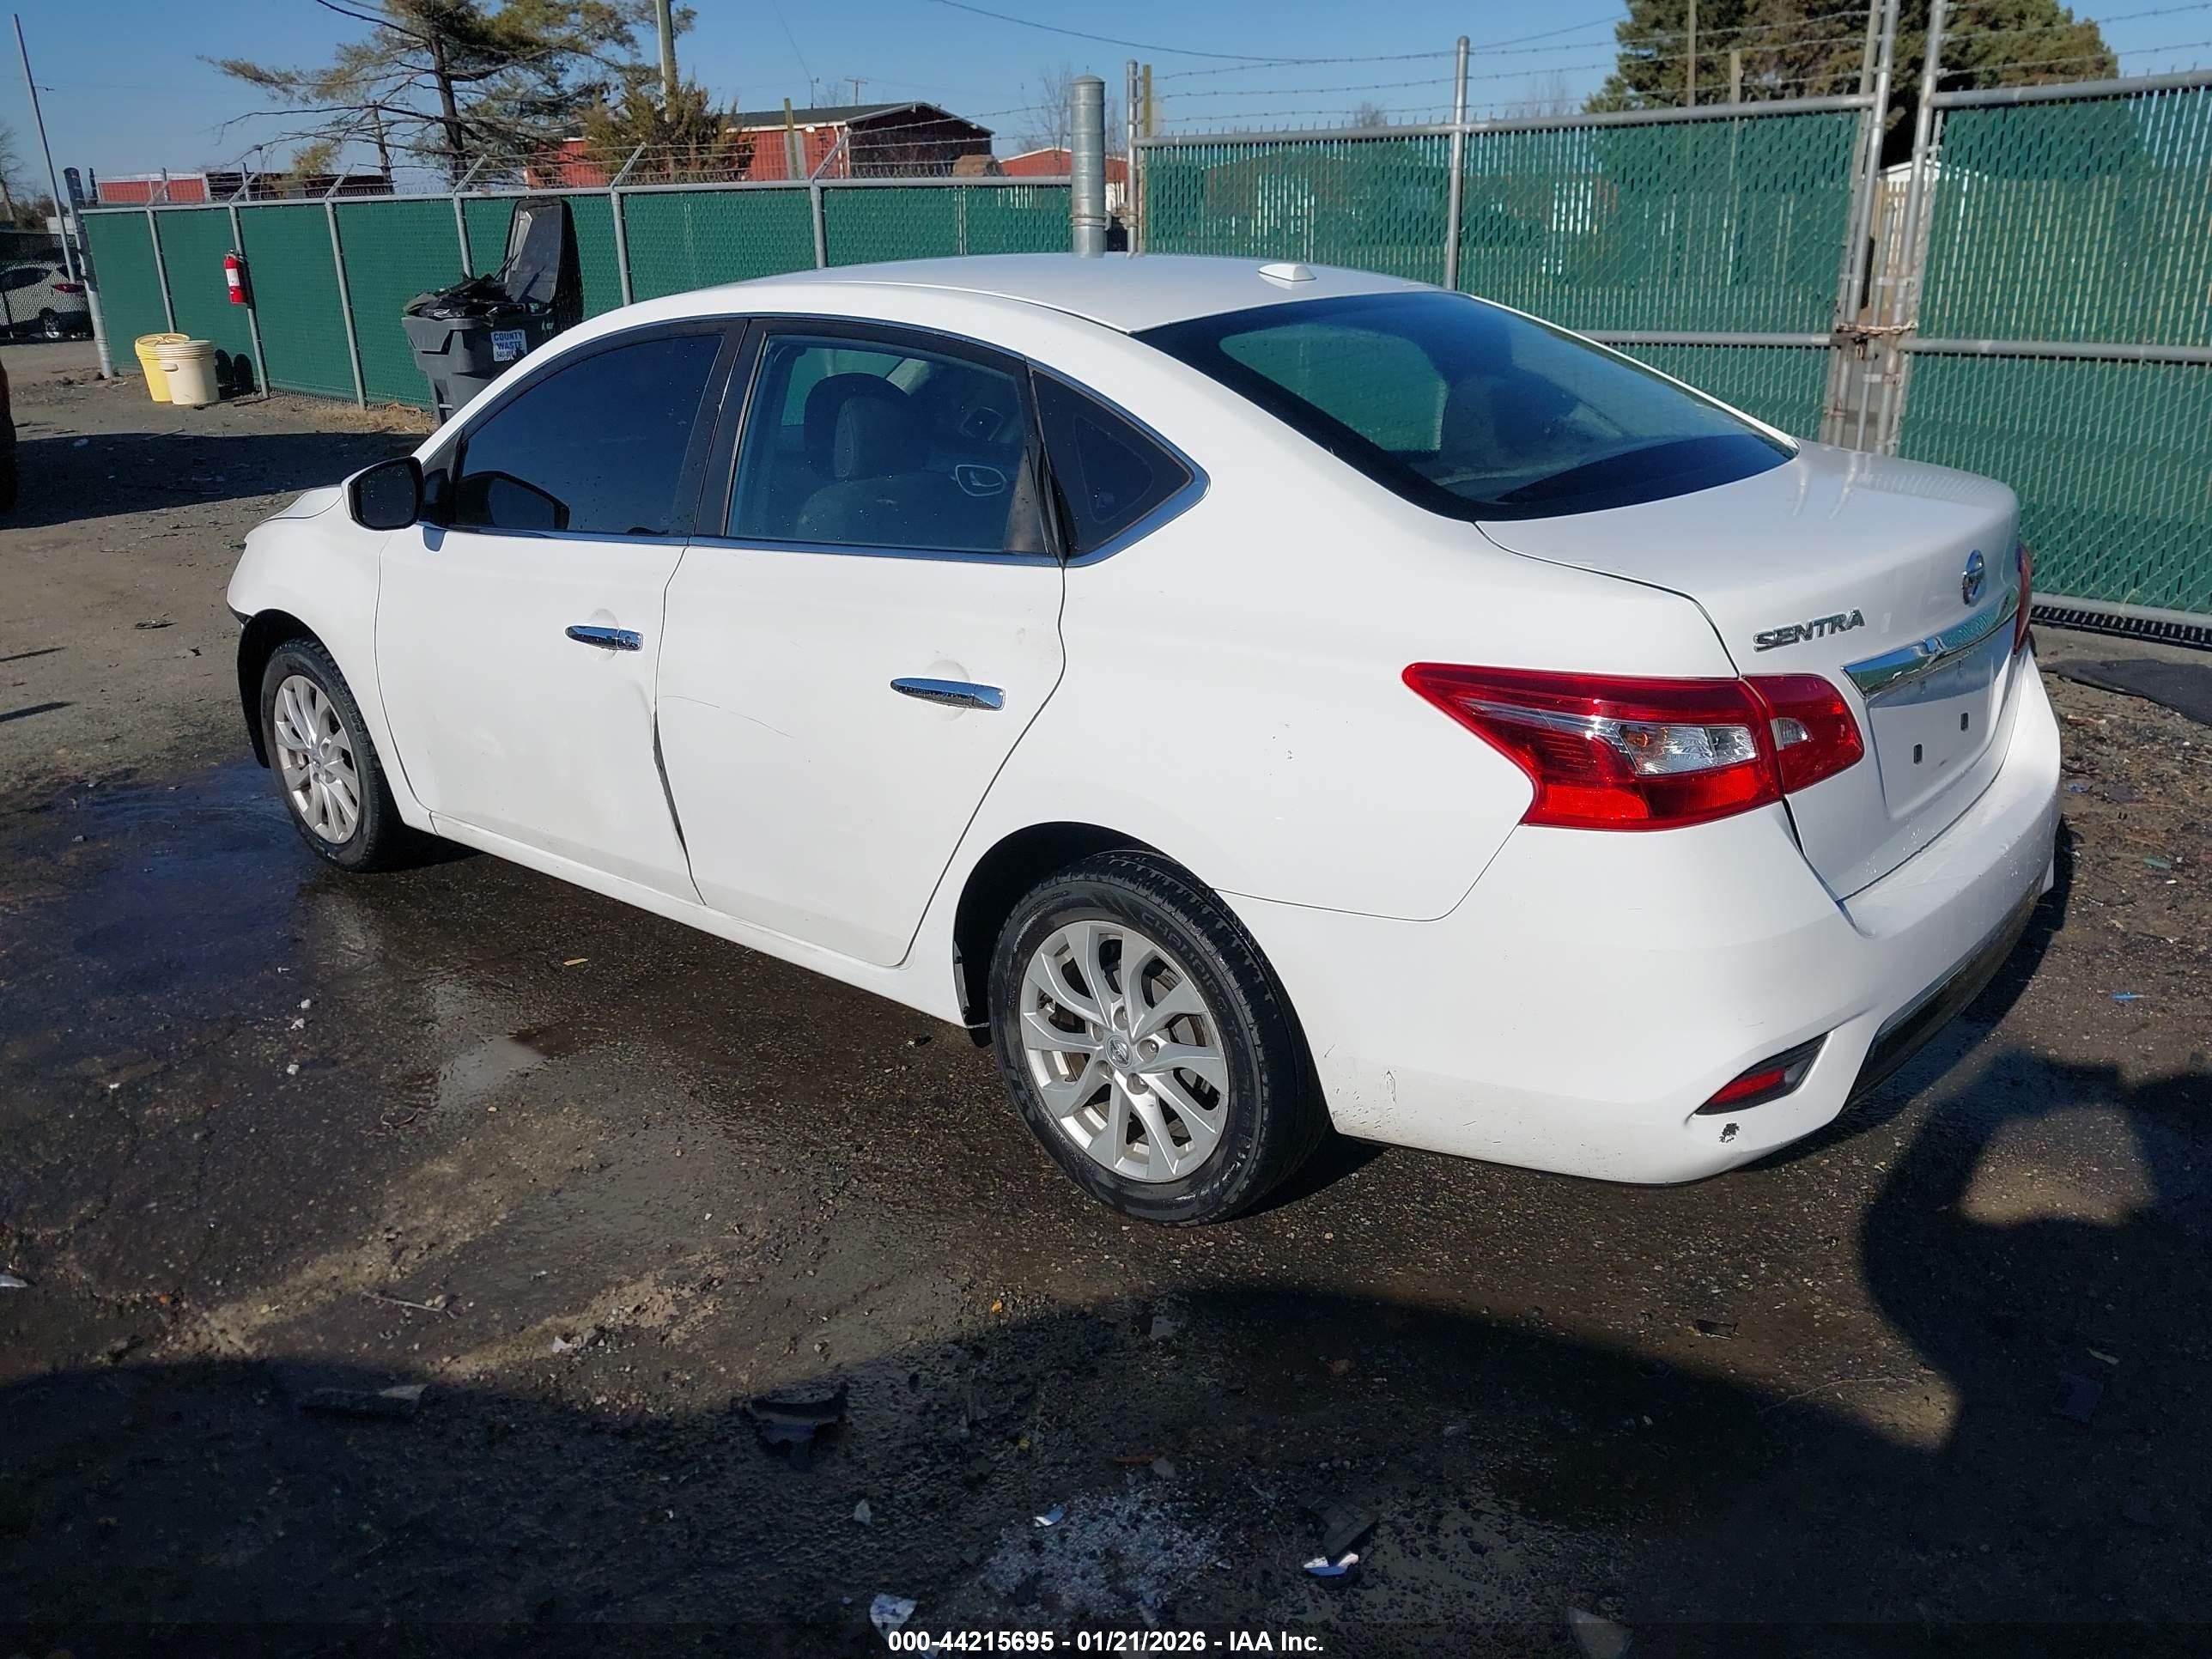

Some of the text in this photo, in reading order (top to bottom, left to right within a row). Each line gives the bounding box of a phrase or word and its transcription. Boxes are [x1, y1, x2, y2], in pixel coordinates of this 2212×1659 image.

[494, 331, 522, 341] COUNTY
[496, 341, 522, 349] WASTE
[1753, 608, 1865, 653] SENTRA
